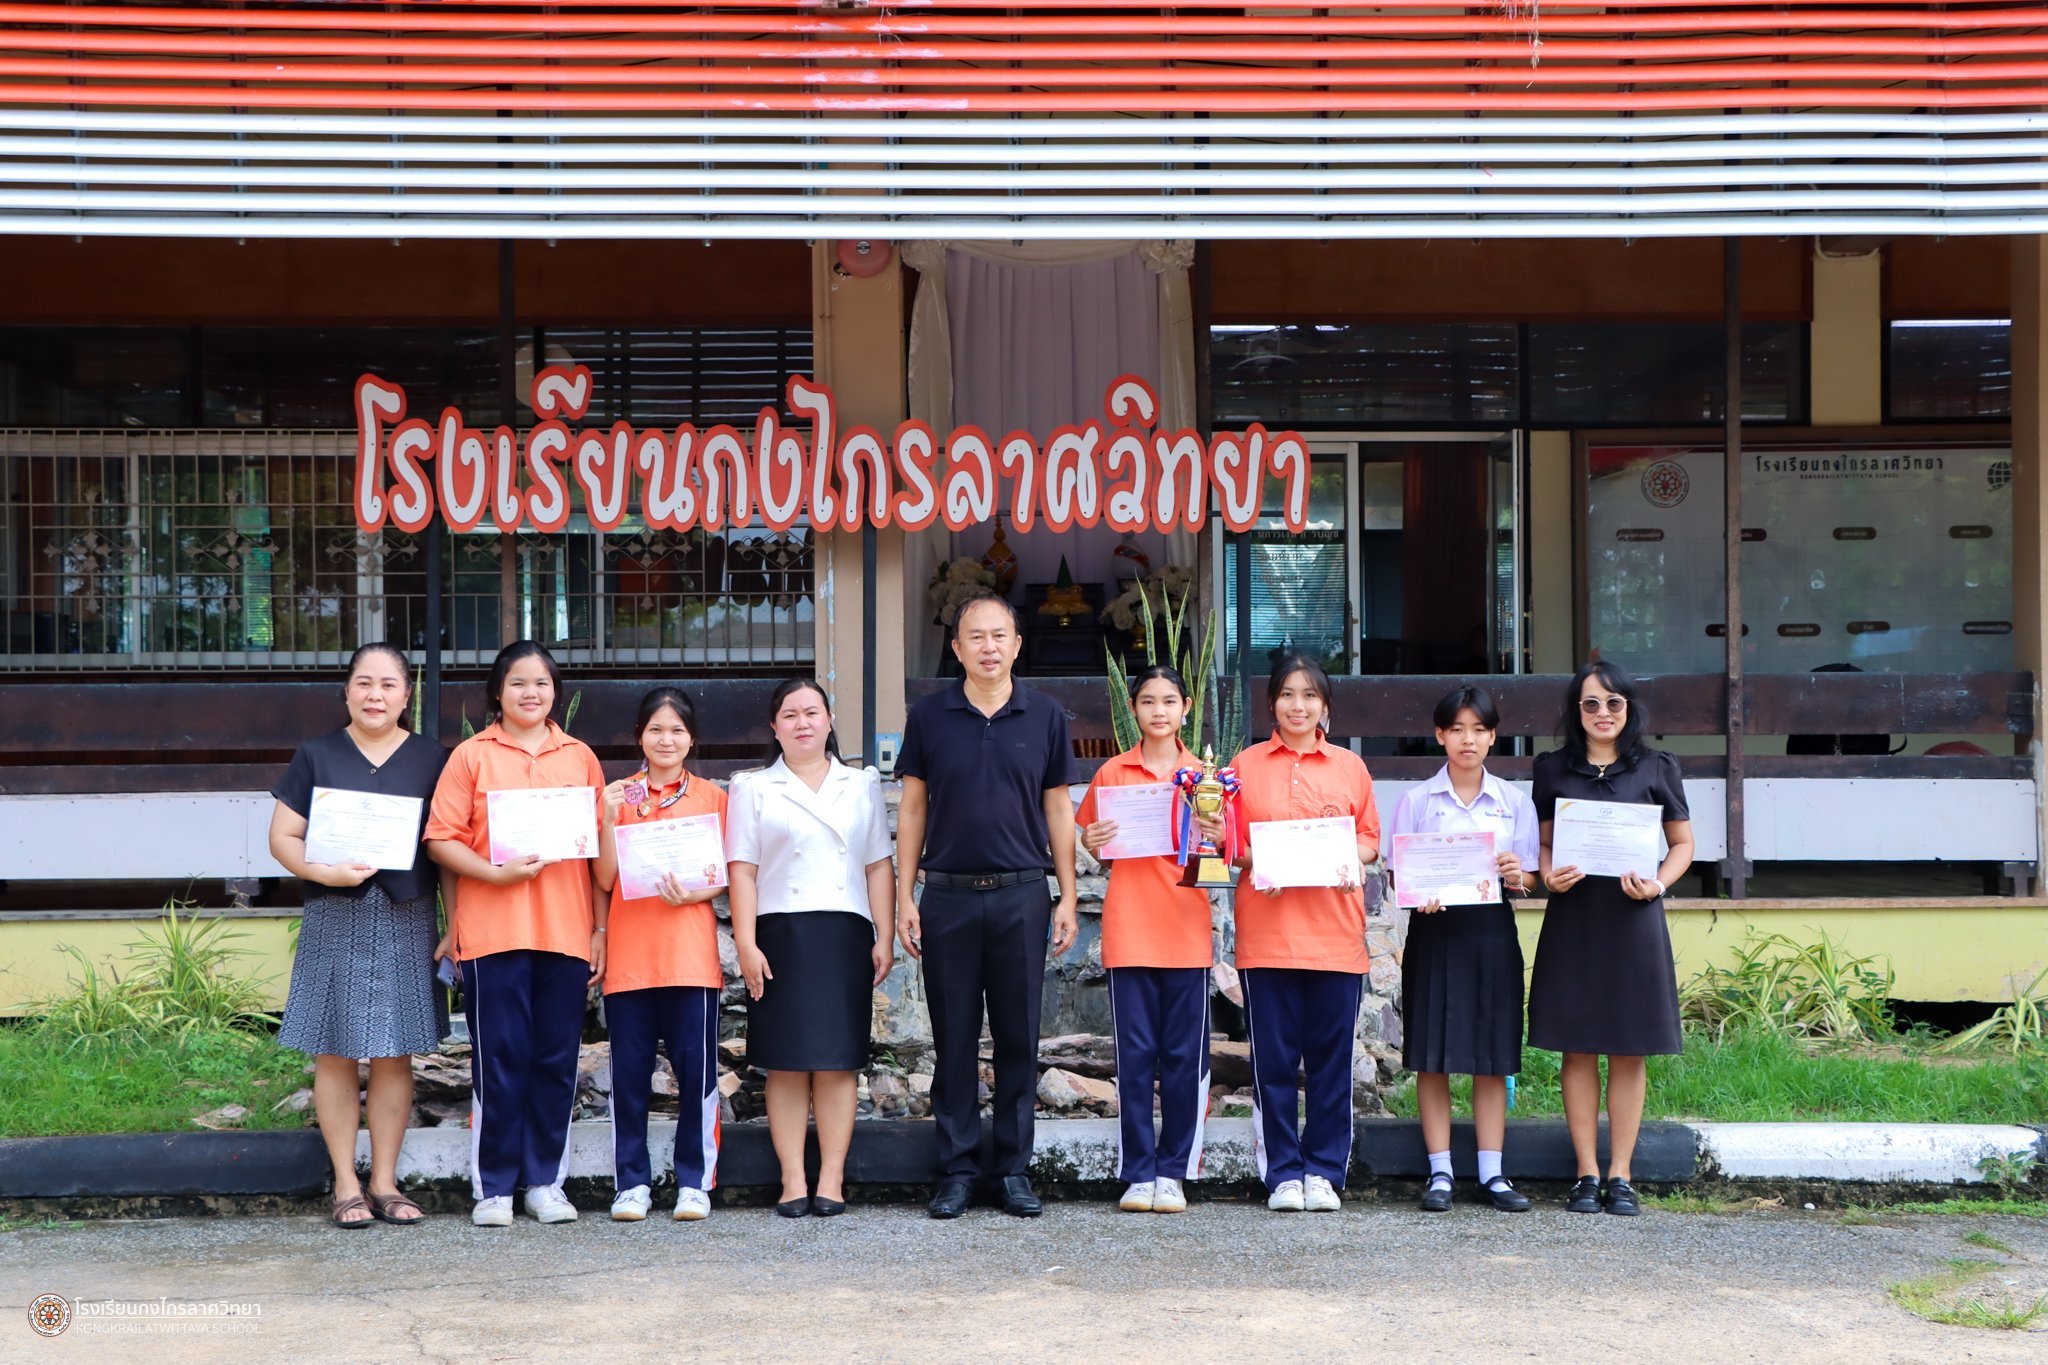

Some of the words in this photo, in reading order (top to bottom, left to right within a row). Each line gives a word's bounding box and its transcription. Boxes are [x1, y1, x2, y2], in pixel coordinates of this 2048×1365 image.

[355, 366, 1312, 535] โรงเรียนกงไกรลาศวิทยา
[1756, 455, 1943, 472] โรงเรียนกงไกรลาศวิทยา
